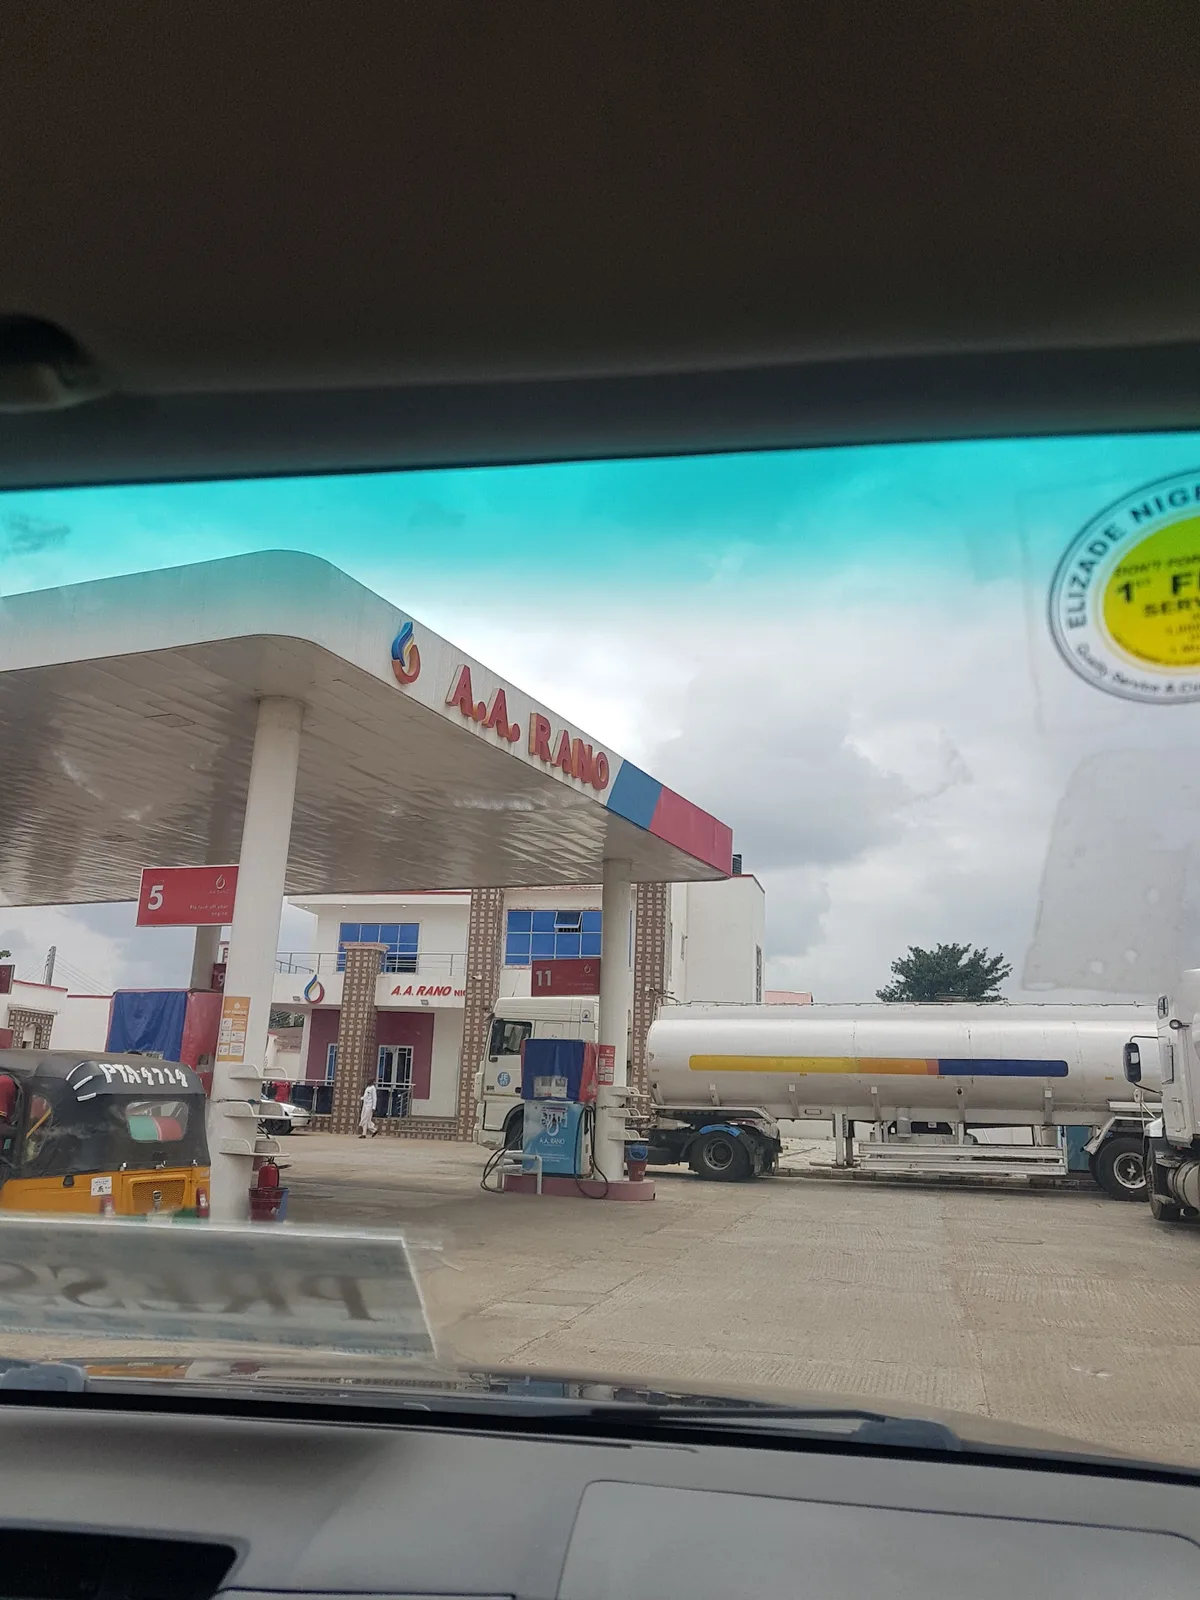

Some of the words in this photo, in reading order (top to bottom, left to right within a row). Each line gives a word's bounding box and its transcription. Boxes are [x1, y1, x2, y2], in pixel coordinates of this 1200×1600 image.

[1068, 525, 1125, 628] ELIZADE
[445, 664, 520, 742] A.A.
[529, 712, 609, 790] RANO
[147, 885, 164, 910] 5
[391, 985, 413, 996] A.A.
[416, 985, 452, 996] RANO
[535, 970, 552, 987] 11
